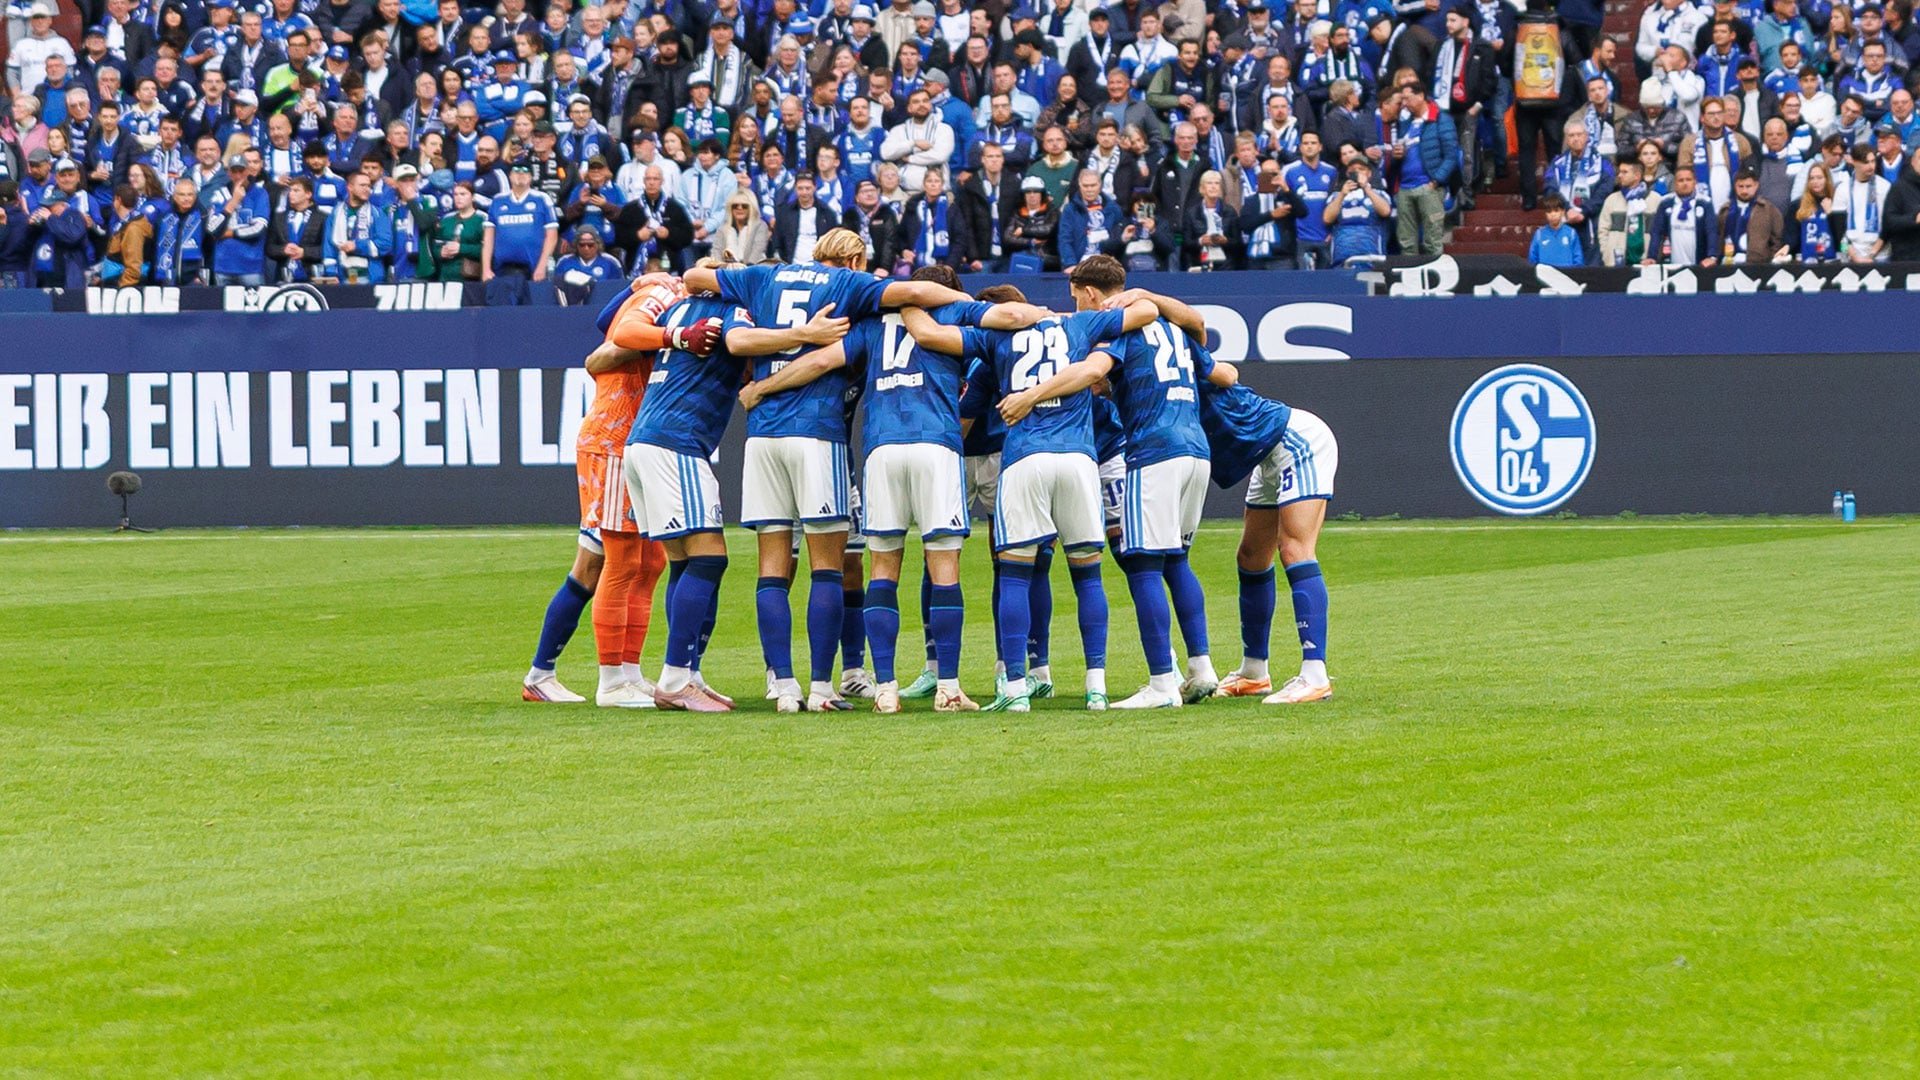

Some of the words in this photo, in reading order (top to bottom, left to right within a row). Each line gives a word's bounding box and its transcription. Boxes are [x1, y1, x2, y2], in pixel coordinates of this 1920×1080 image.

[776, 289, 812, 355] 5
[882, 313, 916, 371] 17
[1142, 320, 1195, 384] 24
[1011, 325, 1070, 391] 23
[128, 371, 251, 468] EIN
[269, 369, 501, 467] LEBEN
[1279, 466, 1293, 492] 5
